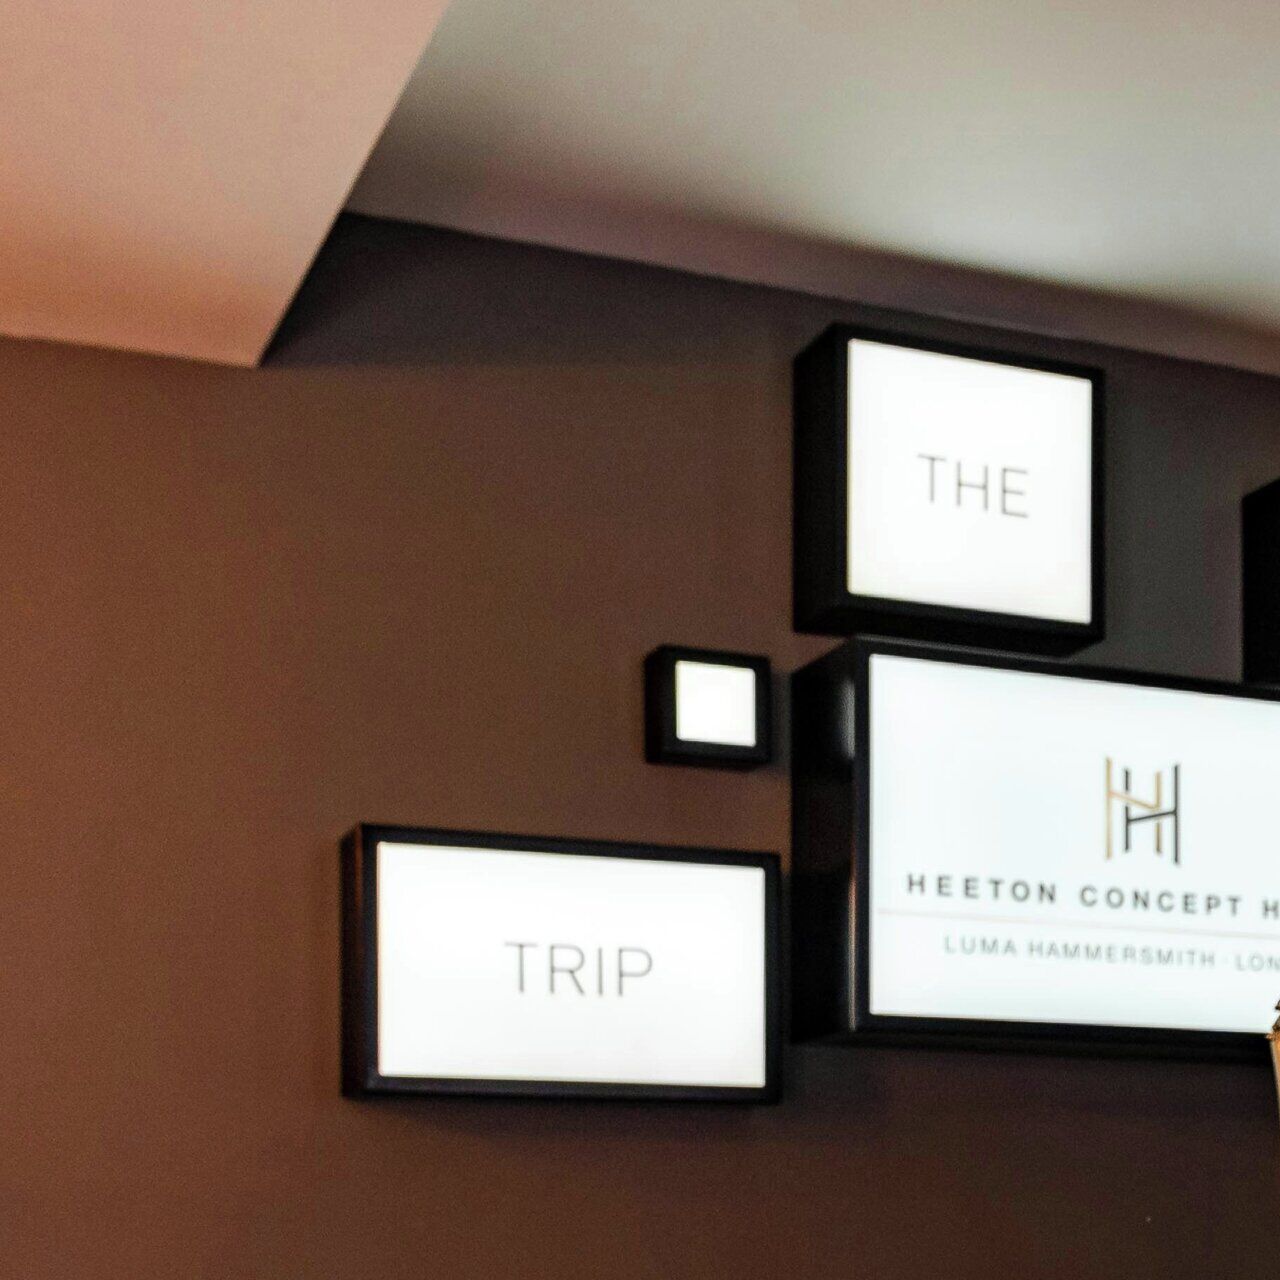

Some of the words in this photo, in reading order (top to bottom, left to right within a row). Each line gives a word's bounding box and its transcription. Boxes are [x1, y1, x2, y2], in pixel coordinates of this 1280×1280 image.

[916, 453, 1029, 519] THE
[906, 873, 1057, 904] HEETON
[1078, 884, 1242, 918] CONCEPT
[504, 940, 653, 998] TRIP
[942, 935, 1017, 957] LUMA
[1028, 939, 1216, 967] HAMMERSMITH
